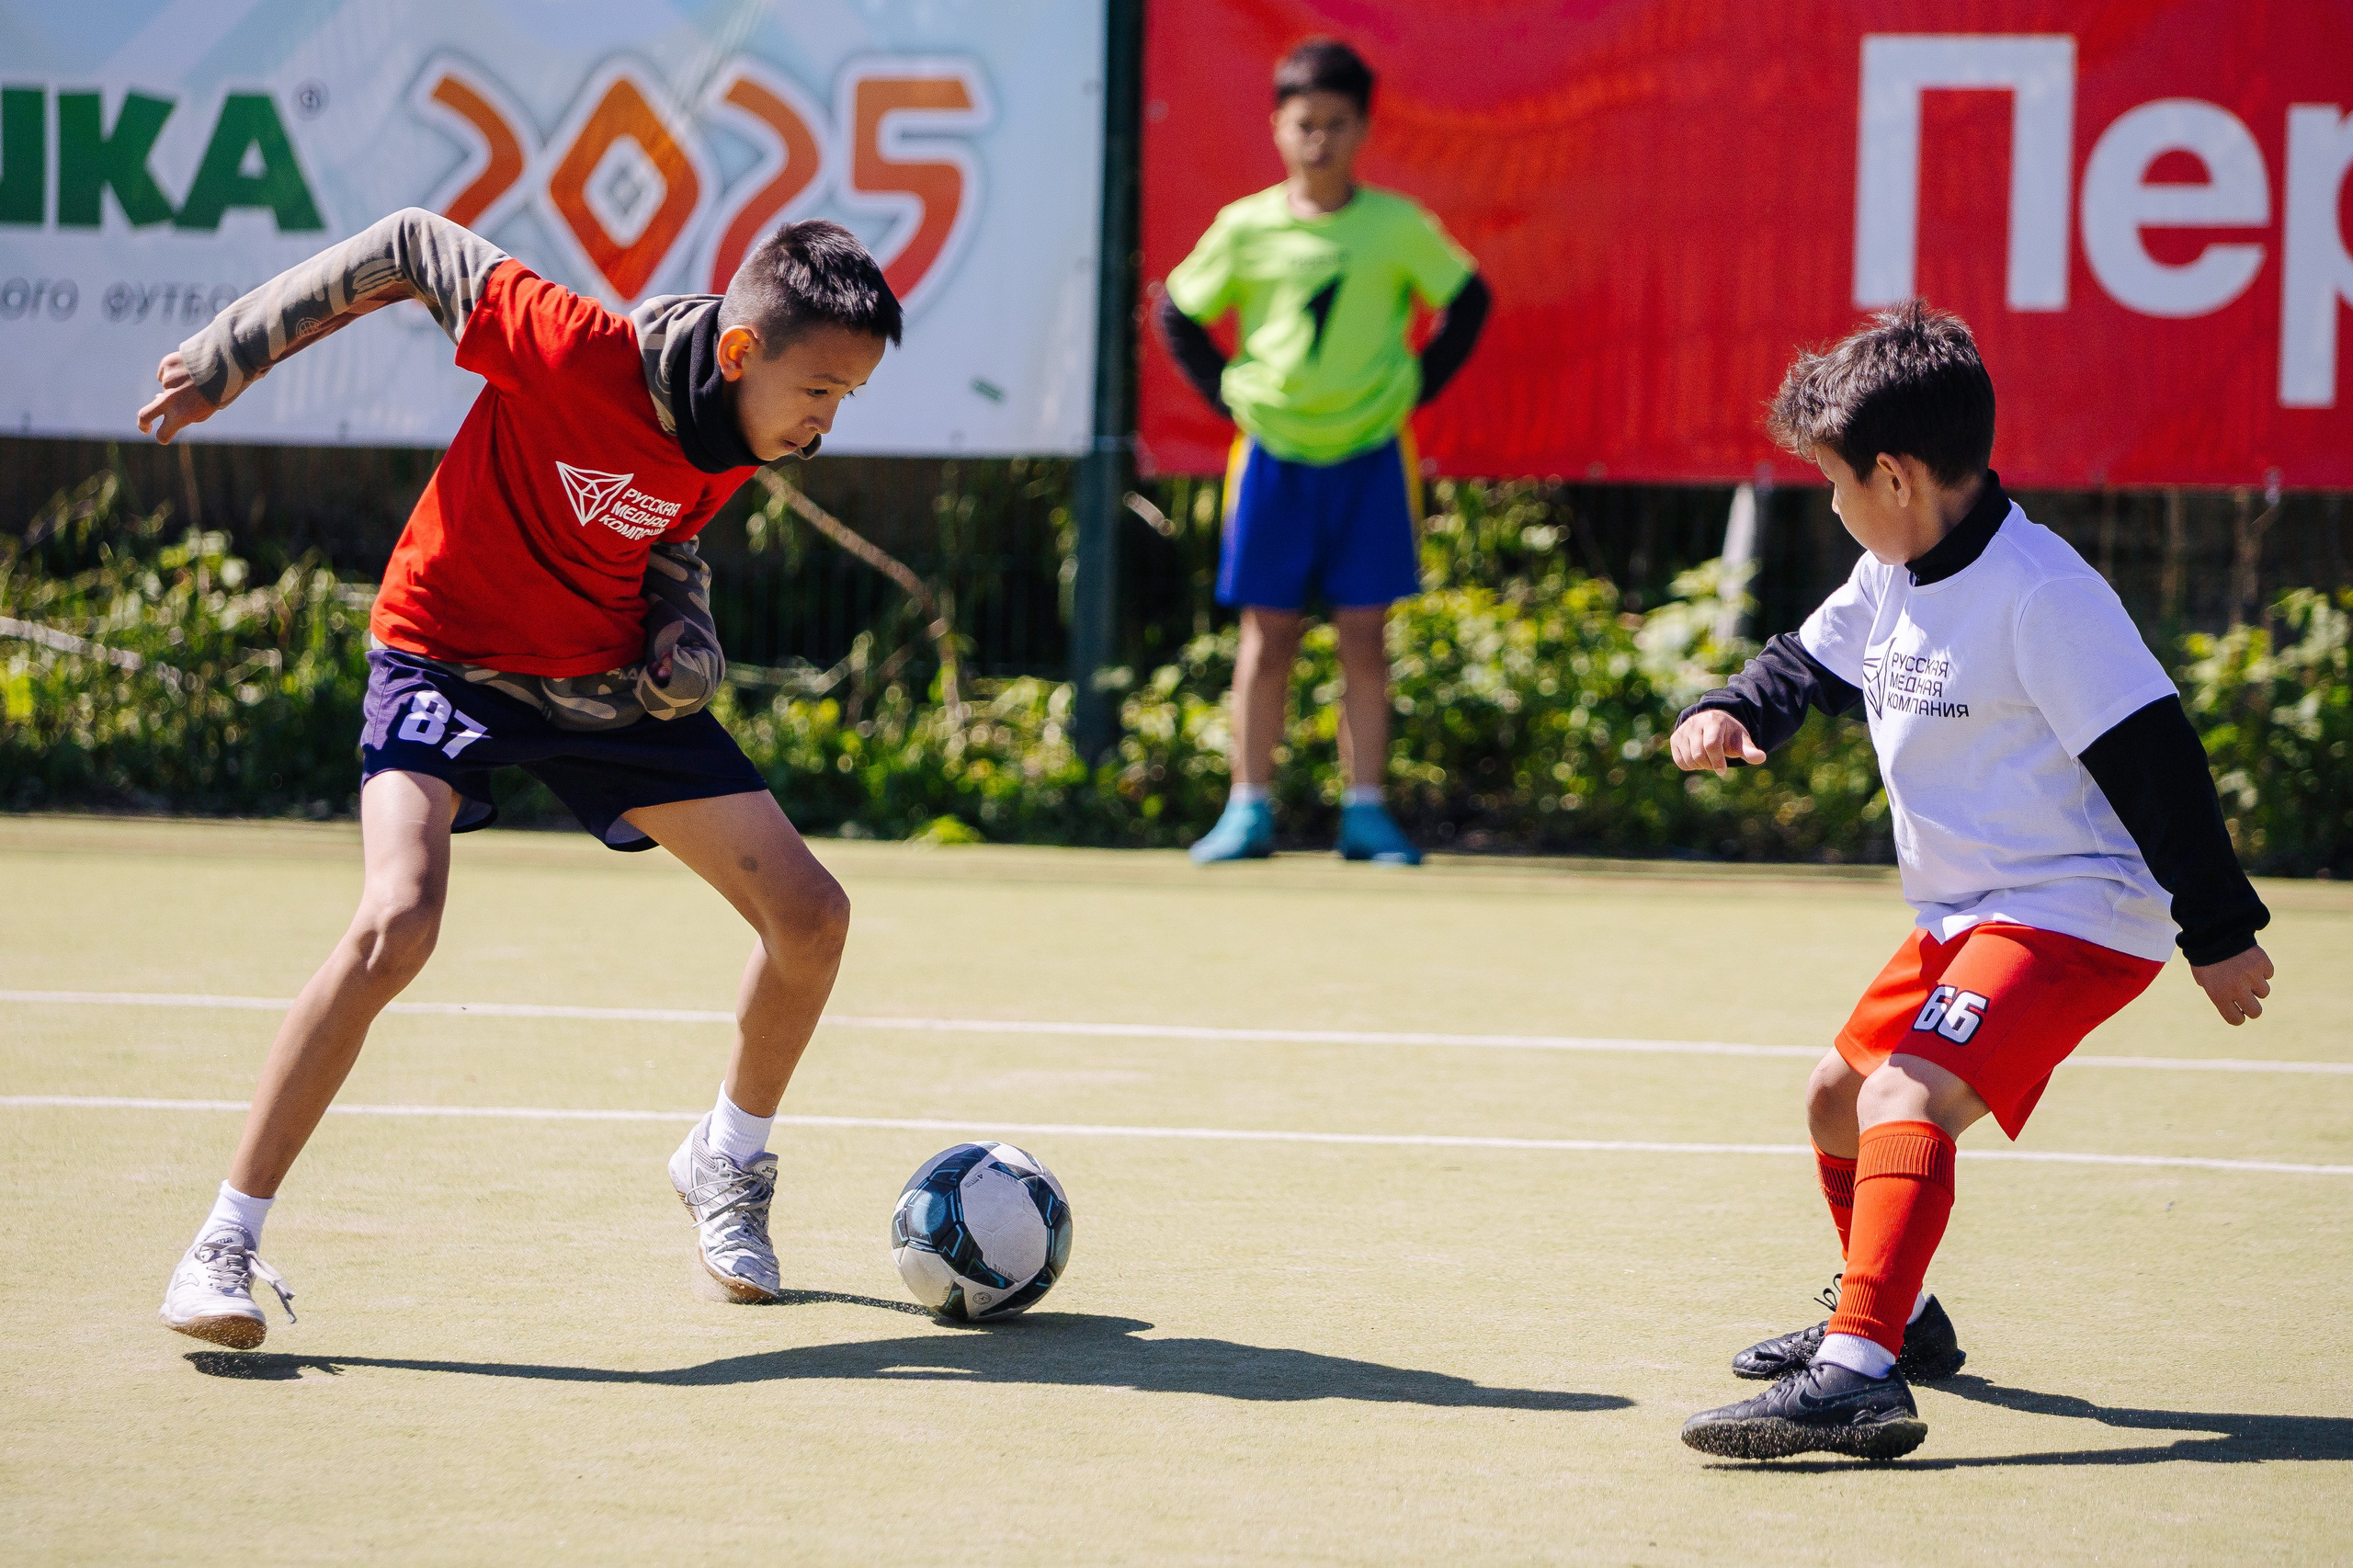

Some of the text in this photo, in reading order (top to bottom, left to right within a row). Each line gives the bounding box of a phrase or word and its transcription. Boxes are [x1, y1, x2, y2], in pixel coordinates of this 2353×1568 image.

[621, 487, 682, 517] РУССКАЯ
[1891, 652, 1949, 678] РУССКАЯ
[1889, 671, 1943, 699] МЕДНАЯ
[1886, 690, 1970, 719] КОМПАНИЯ
[398, 689, 488, 760] 87
[1912, 984, 1991, 1046] 66
